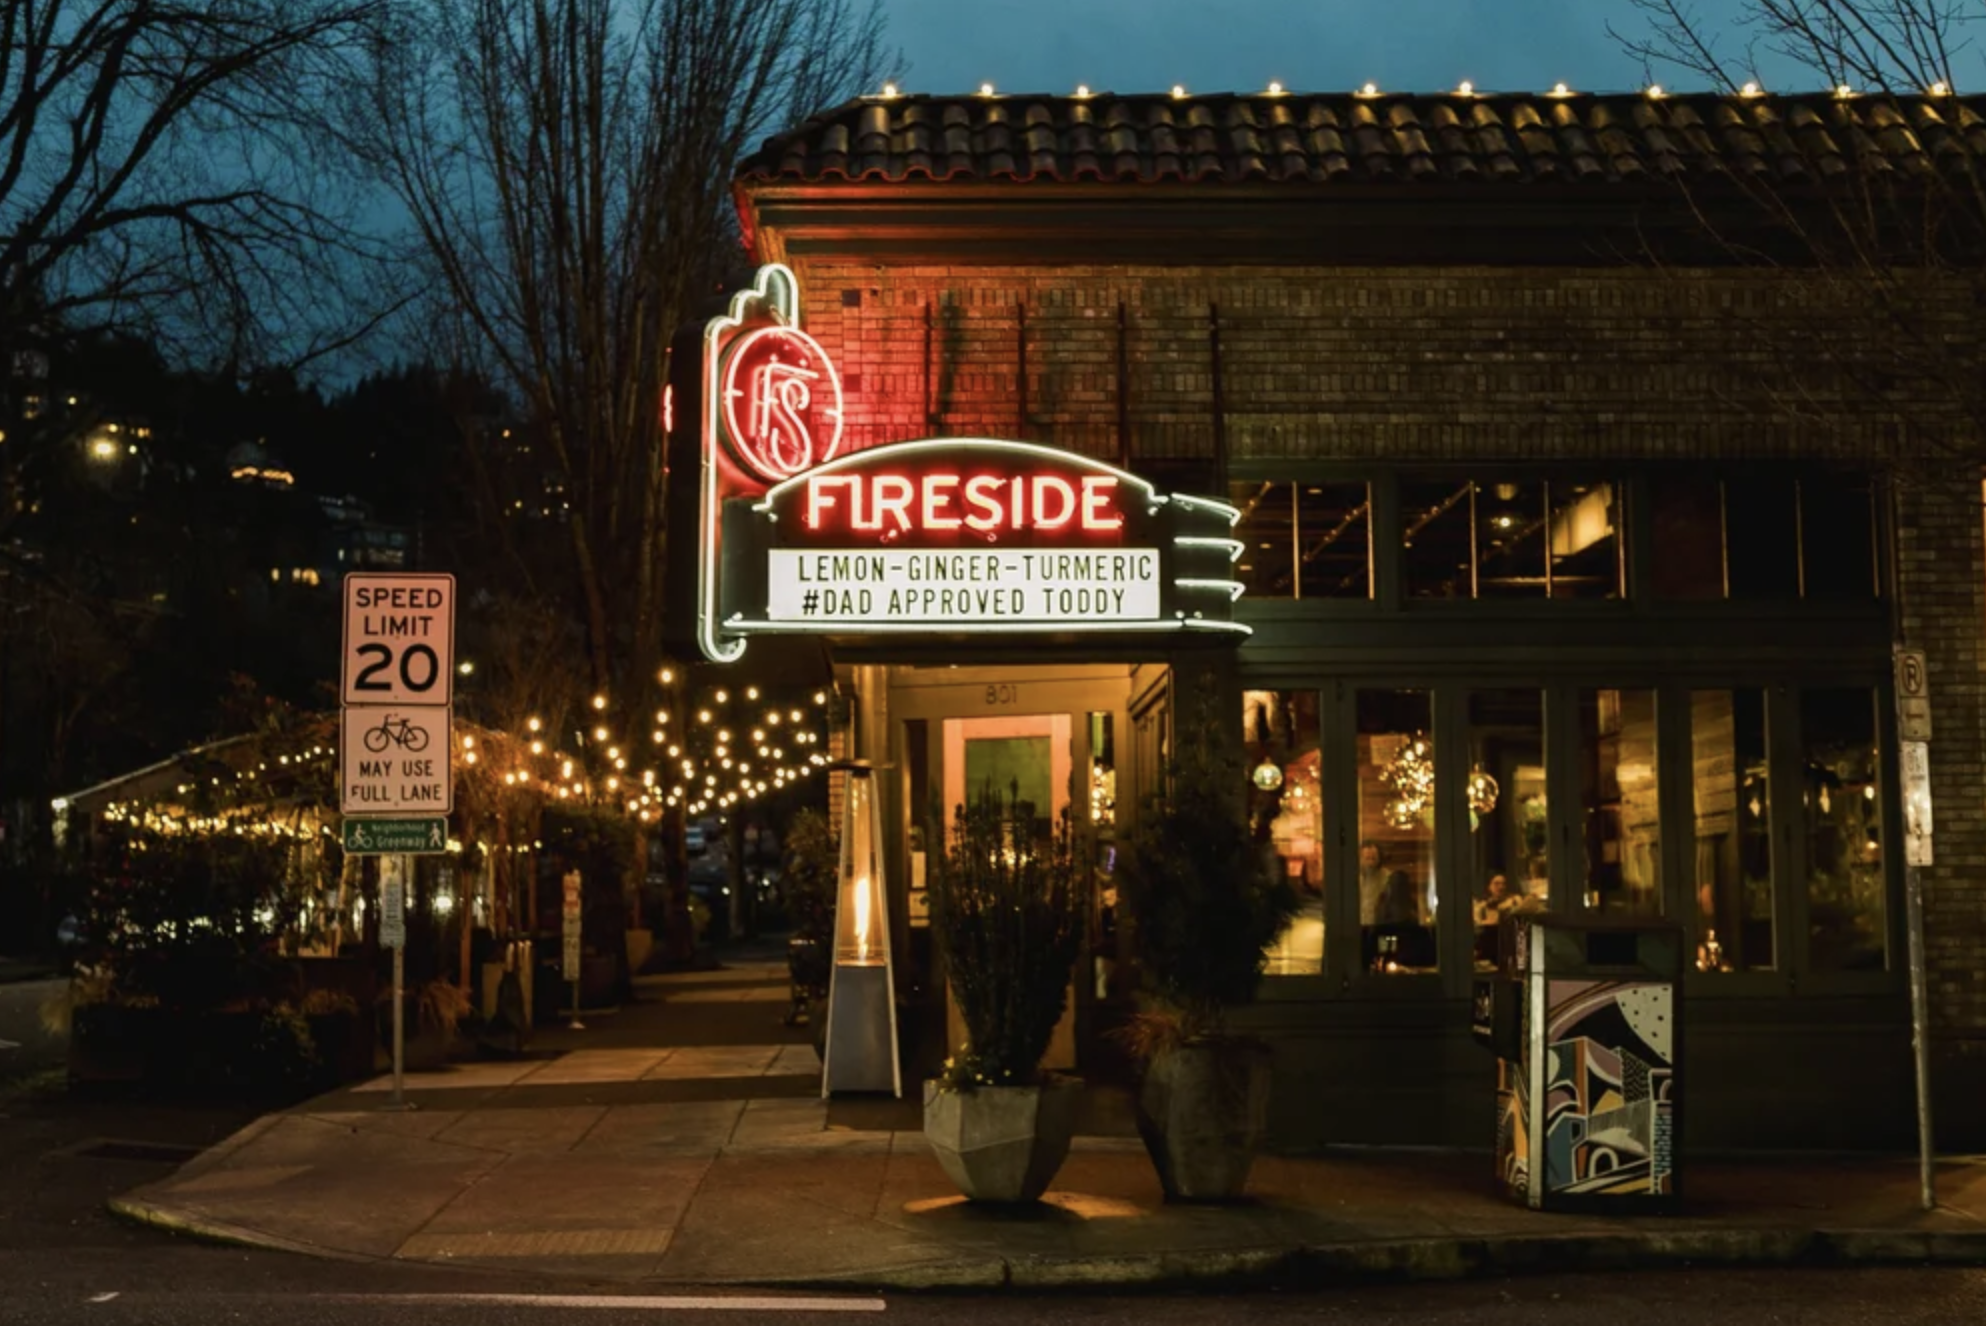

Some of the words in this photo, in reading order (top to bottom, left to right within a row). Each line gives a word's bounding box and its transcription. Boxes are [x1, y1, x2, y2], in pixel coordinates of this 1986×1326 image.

[807, 474, 1124, 531] FIRESIDE
[355, 587, 443, 608] SPEED
[802, 589, 873, 615] #DAD
[887, 588, 1025, 615] APPROVED
[1043, 588, 1126, 614] TODDY
[363, 614, 434, 636] LIMIT
[353, 642, 439, 692] 20
[985, 684, 1017, 705] 801
[359, 760, 393, 777] MAY
[402, 760, 434, 777] USE
[350, 784, 391, 802] FULL
[401, 784, 443, 802] LANE
[376, 835, 426, 850] Greenway
